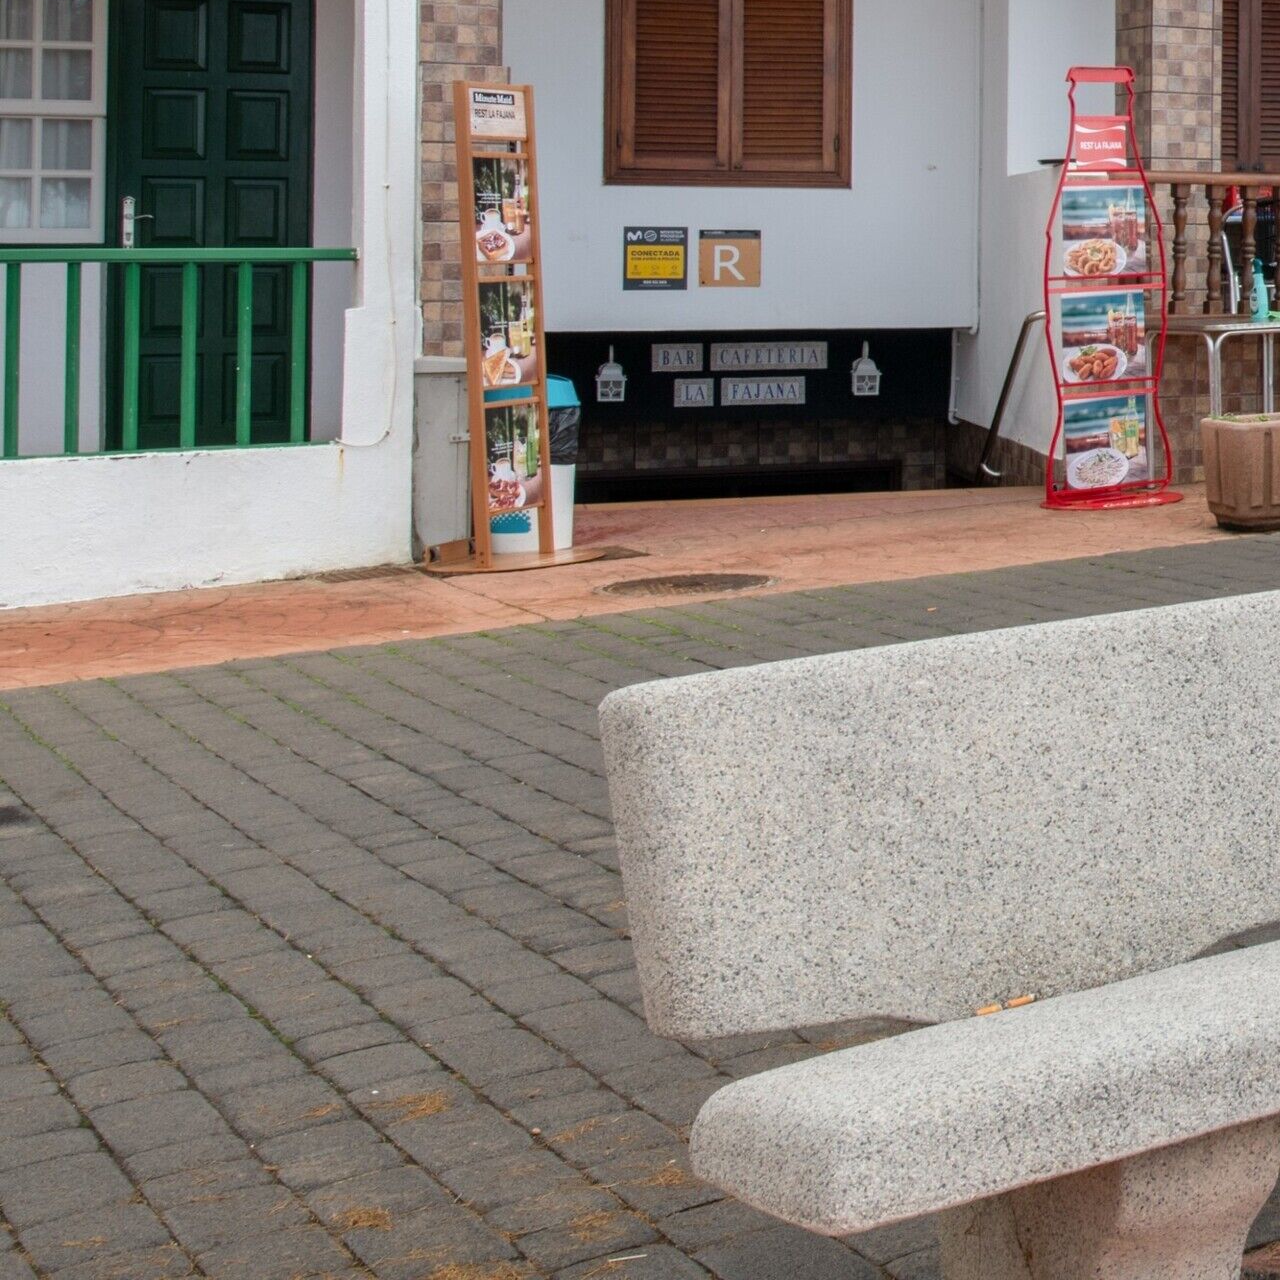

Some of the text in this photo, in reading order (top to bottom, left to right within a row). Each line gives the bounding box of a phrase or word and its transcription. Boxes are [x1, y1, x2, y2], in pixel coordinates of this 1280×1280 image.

[713, 244, 746, 281] R
[662, 349, 695, 366] BAR
[685, 383, 798, 401] LA FAJANA
